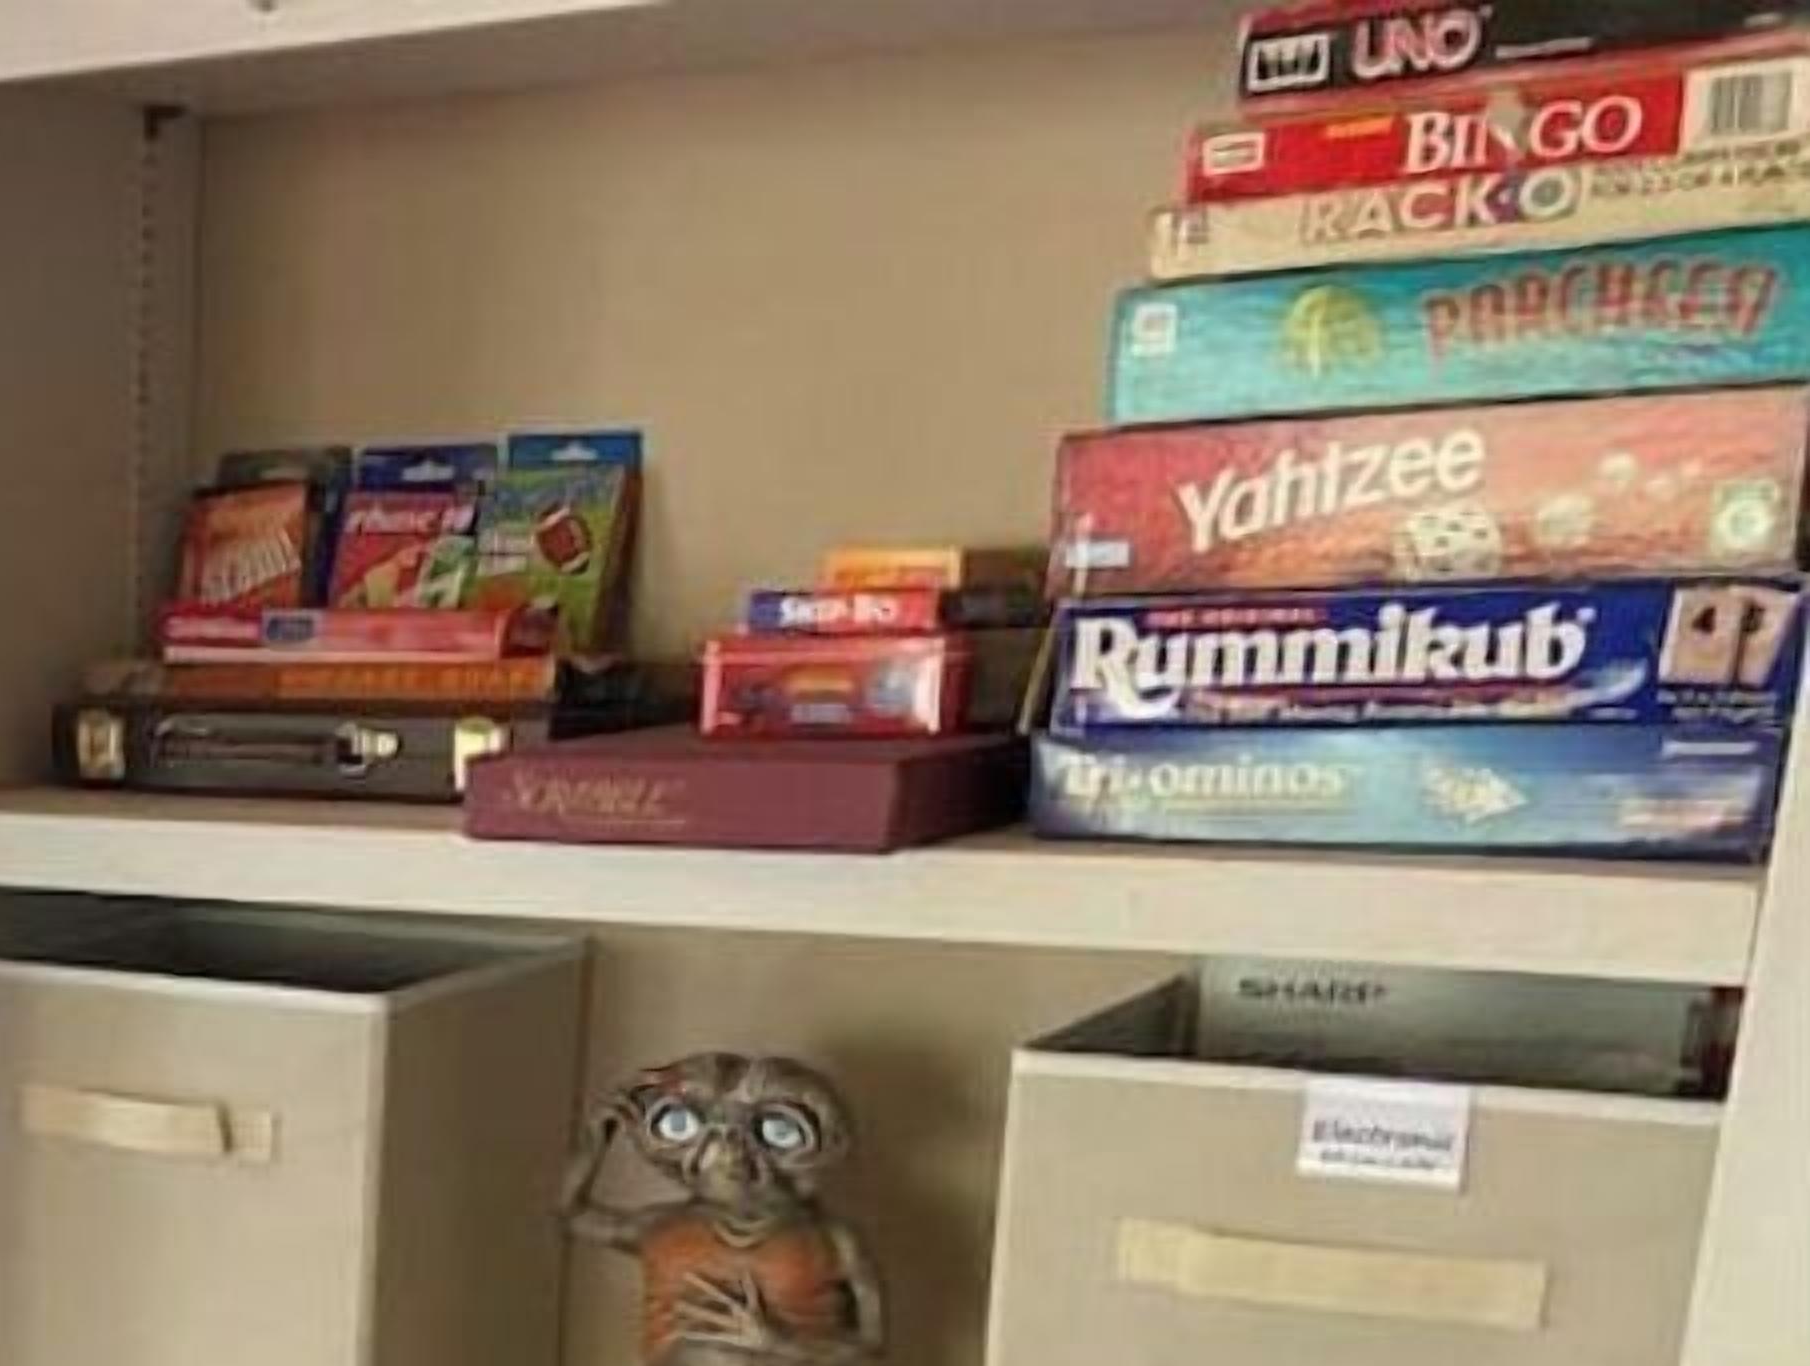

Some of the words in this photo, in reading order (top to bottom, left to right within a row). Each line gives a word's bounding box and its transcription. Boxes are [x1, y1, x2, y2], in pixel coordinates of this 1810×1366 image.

[1350, 11, 1482, 79] UNO
[1404, 94, 1643, 175] BINGO
[1175, 428, 1487, 553] Yahtzee
[1069, 602, 1588, 720] Rummikub
[1238, 976, 1387, 1004] SHARP
